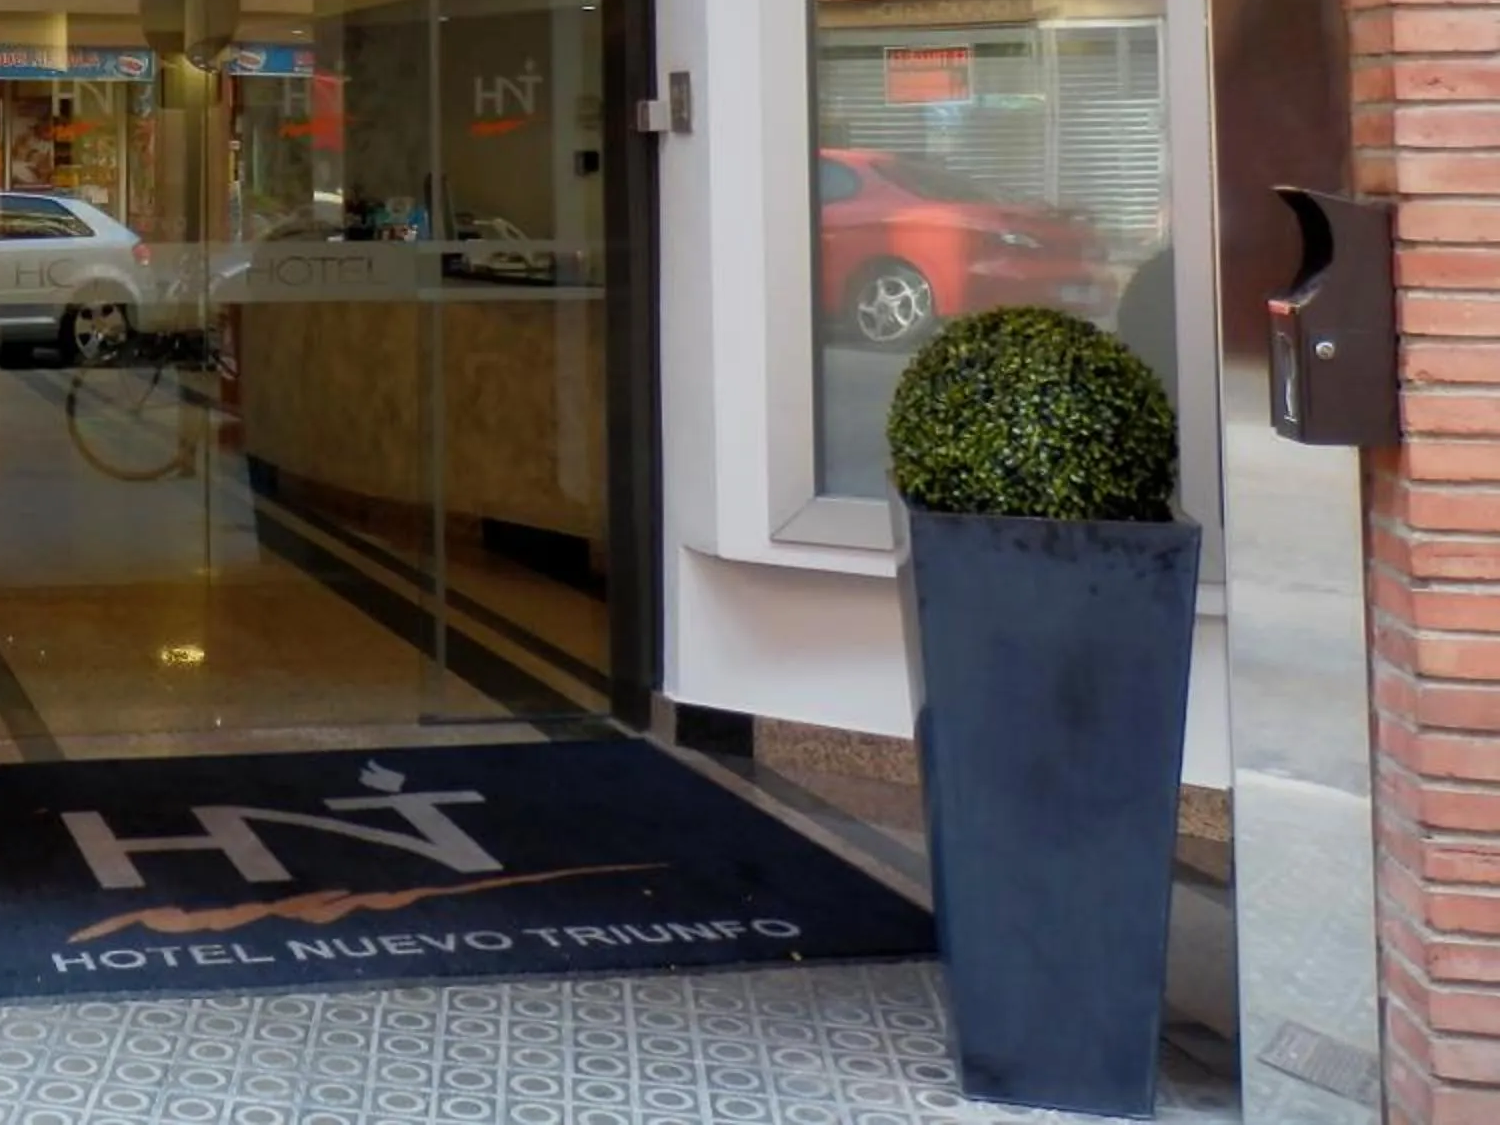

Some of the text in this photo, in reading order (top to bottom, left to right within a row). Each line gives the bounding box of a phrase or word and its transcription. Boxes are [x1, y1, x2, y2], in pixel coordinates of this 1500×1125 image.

[50, 918, 801, 975] HOTEL NUEVO TRIUNFO
